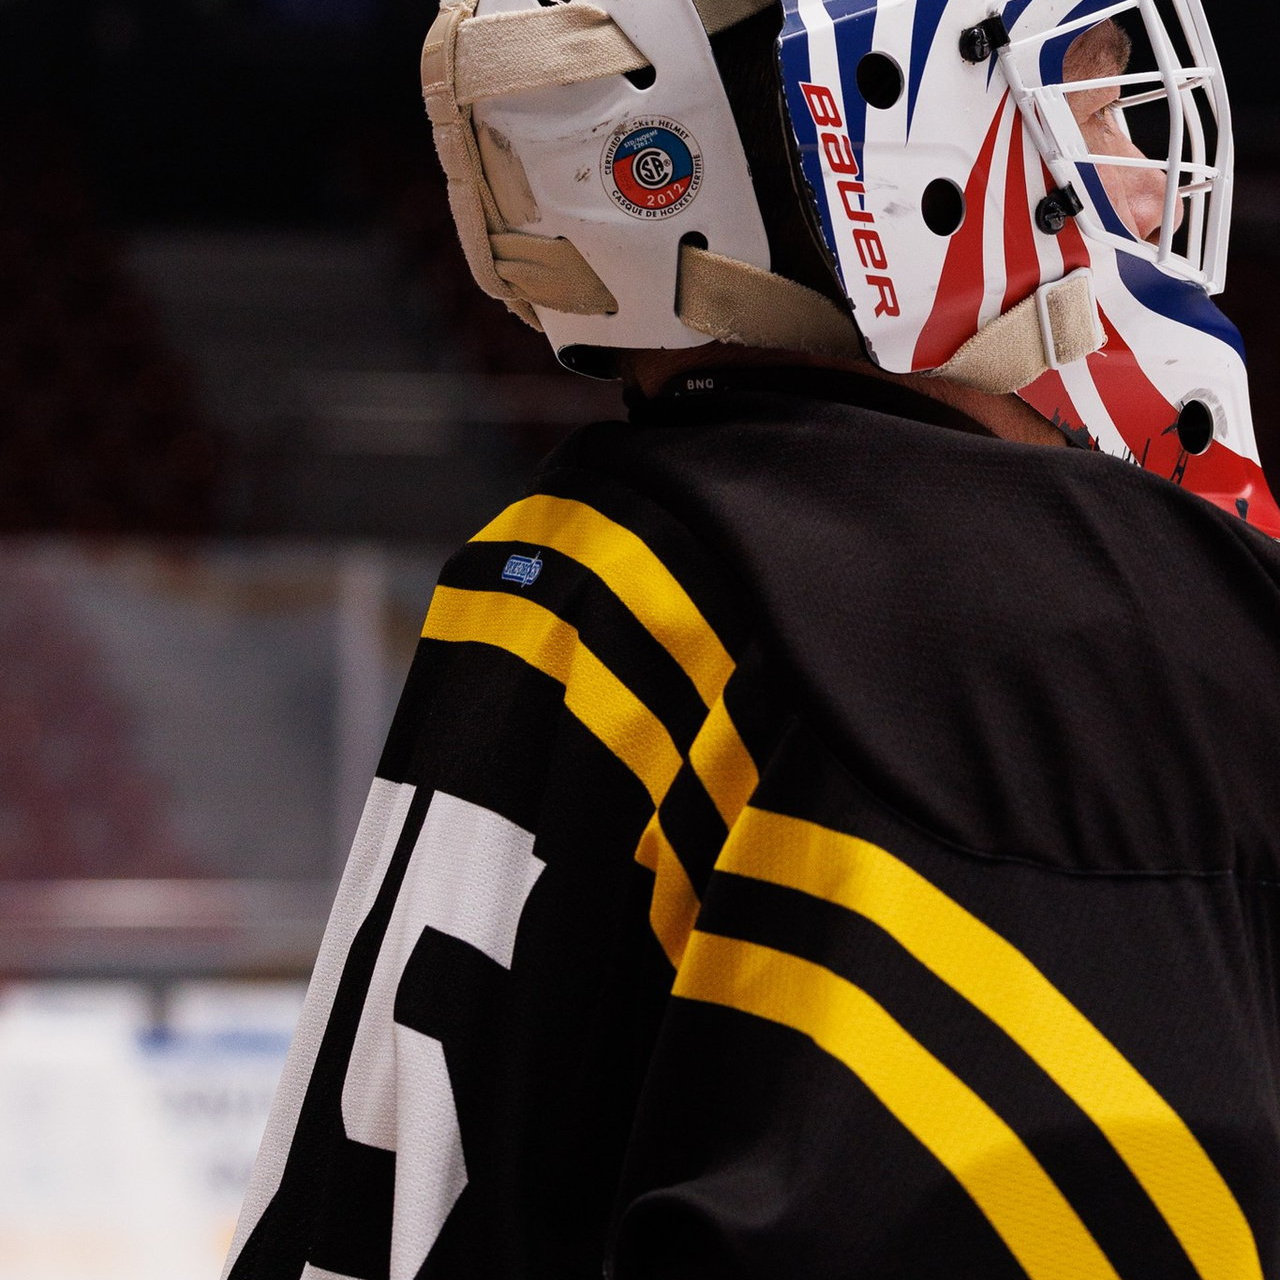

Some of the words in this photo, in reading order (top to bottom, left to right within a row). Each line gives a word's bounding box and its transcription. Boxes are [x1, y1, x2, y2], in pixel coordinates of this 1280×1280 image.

[604, 135, 621, 176] CERTIFIED
[658, 120, 690, 140] HELMET
[612, 190, 643, 216] CASQUE
[660, 192, 693, 217] HOCKEY
[647, 183, 685, 206] 2012
[800, 82, 901, 318] BAUER
